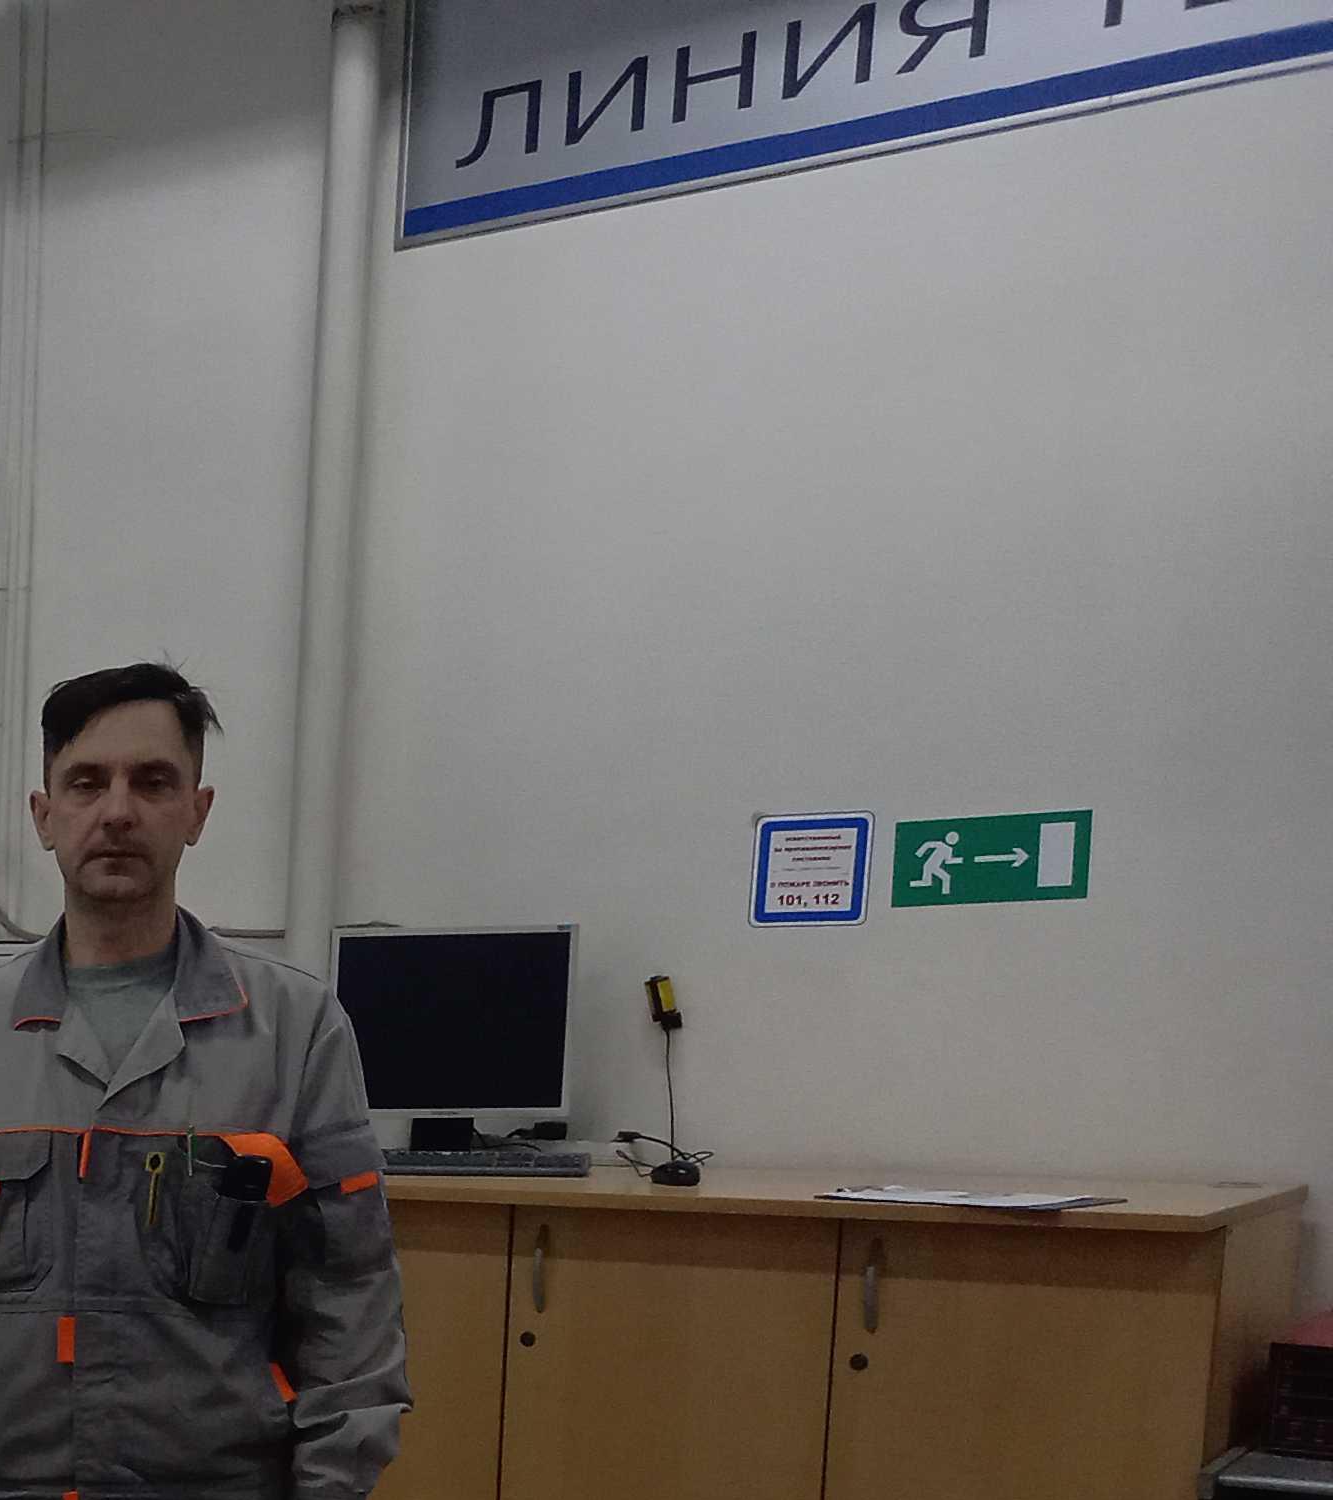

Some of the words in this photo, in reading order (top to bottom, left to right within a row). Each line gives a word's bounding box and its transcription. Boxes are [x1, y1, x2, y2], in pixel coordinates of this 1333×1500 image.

[455, 0, 989, 169] ЛИНИЯ
[777, 894, 808, 907] 101,
[813, 893, 840, 905] 112
